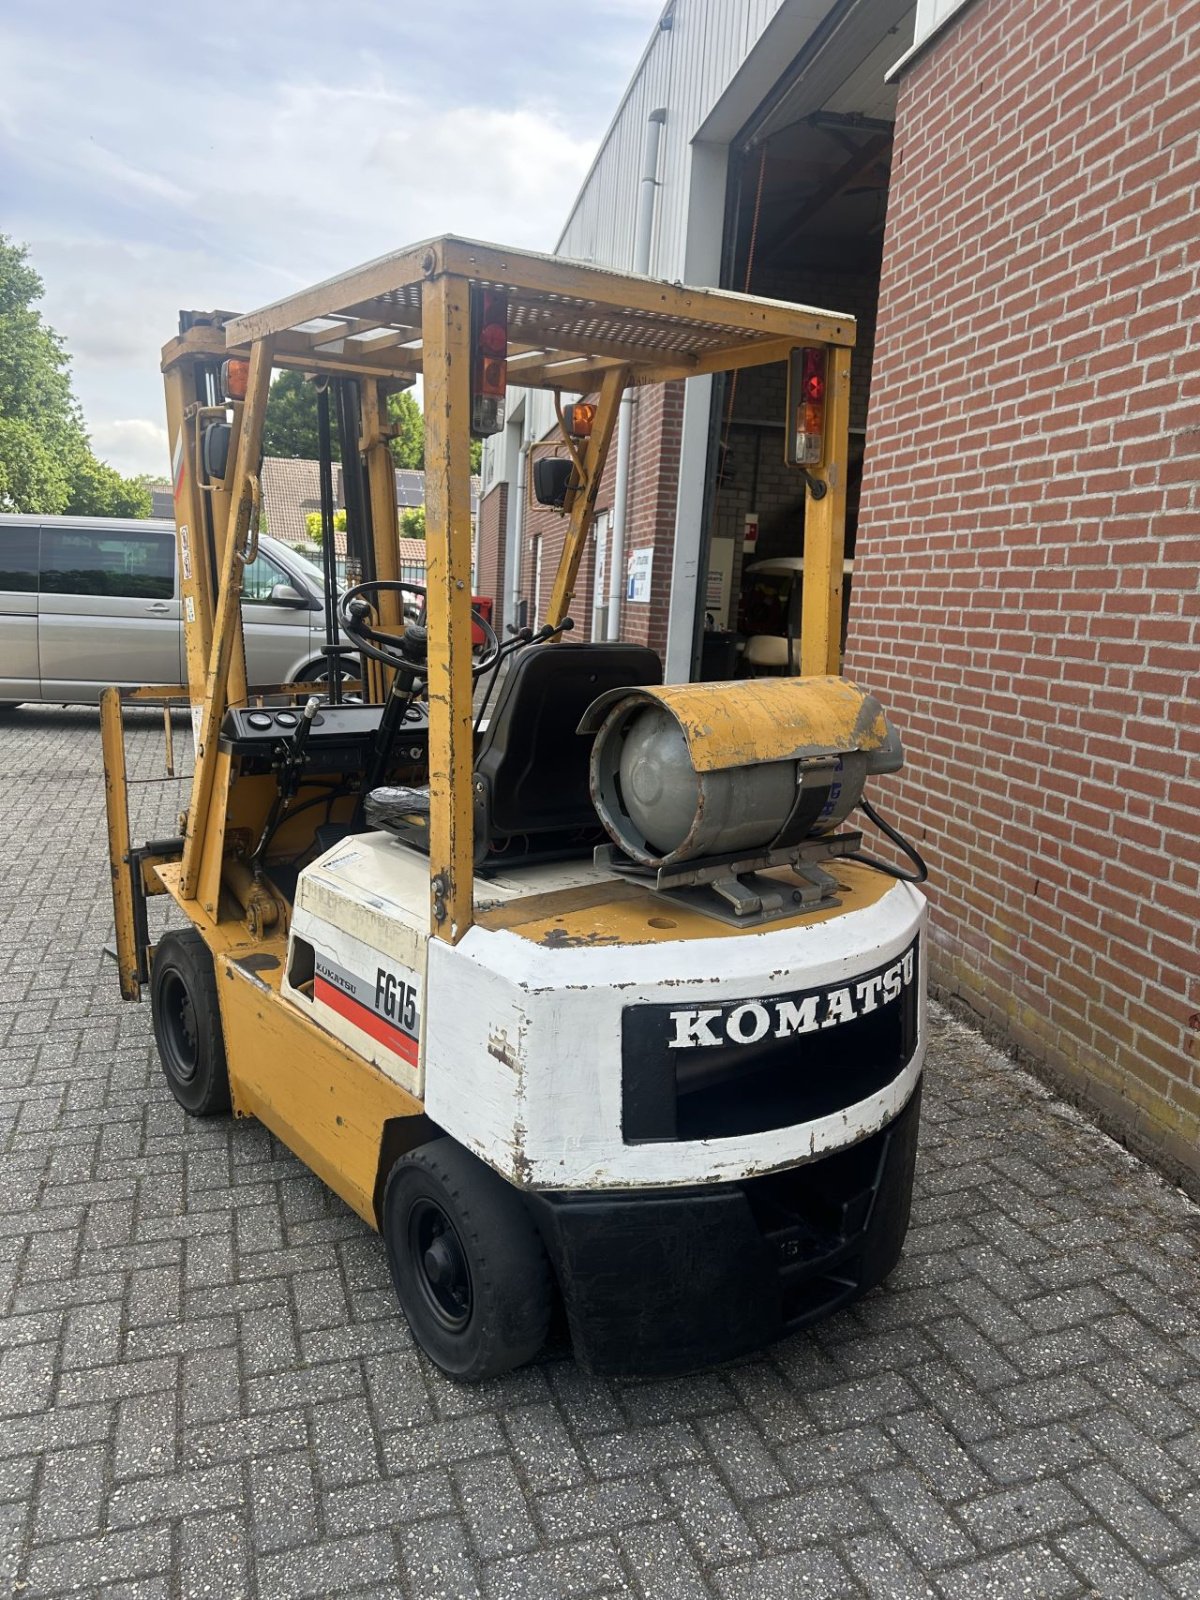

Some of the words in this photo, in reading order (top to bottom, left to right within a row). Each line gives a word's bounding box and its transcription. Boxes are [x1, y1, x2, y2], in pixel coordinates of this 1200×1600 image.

[316, 962, 357, 994] KOMATSU
[375, 967, 417, 1031] FG15
[668, 948, 914, 1048] KOMATSU
